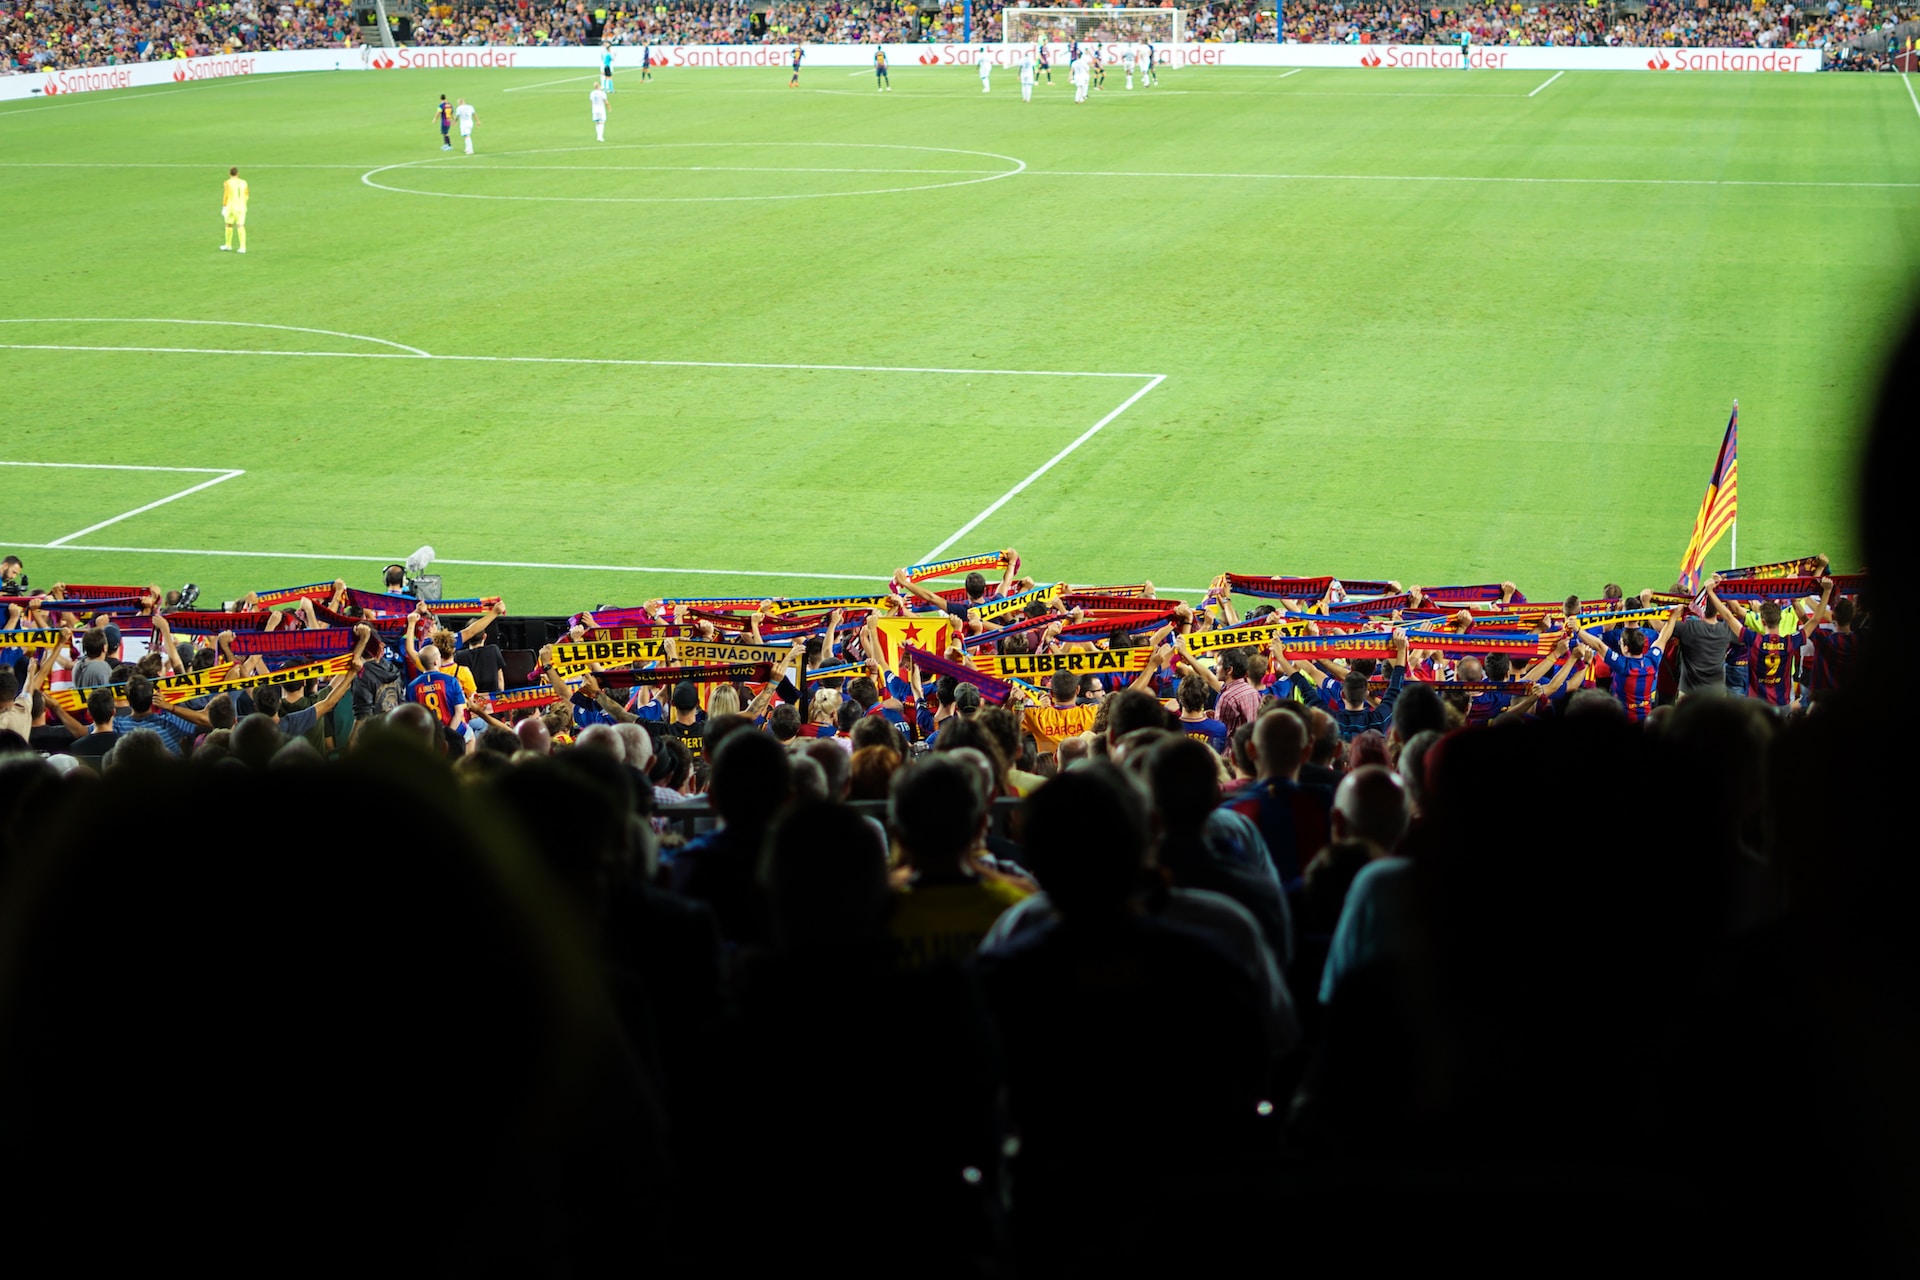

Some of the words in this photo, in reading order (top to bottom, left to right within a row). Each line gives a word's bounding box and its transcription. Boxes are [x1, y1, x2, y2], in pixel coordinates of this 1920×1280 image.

[398, 48, 517, 68] Santander
[673, 46, 789, 67] Santander
[944, 45, 1060, 65] Santandr
[1107, 44, 1225, 65] Sander
[1674, 50, 1802, 72] Santander
[186, 55, 256, 81] Santander
[58, 67, 132, 95] Santander
[558, 641, 667, 663] LLIBERTA
[1001, 651, 1130, 675] LLIBERTAT
[1764, 653, 1781, 676] 9
[425, 693, 442, 721] 8
[1045, 723, 1084, 737] BARÇA
[1187, 732, 1209, 743] ESSI
